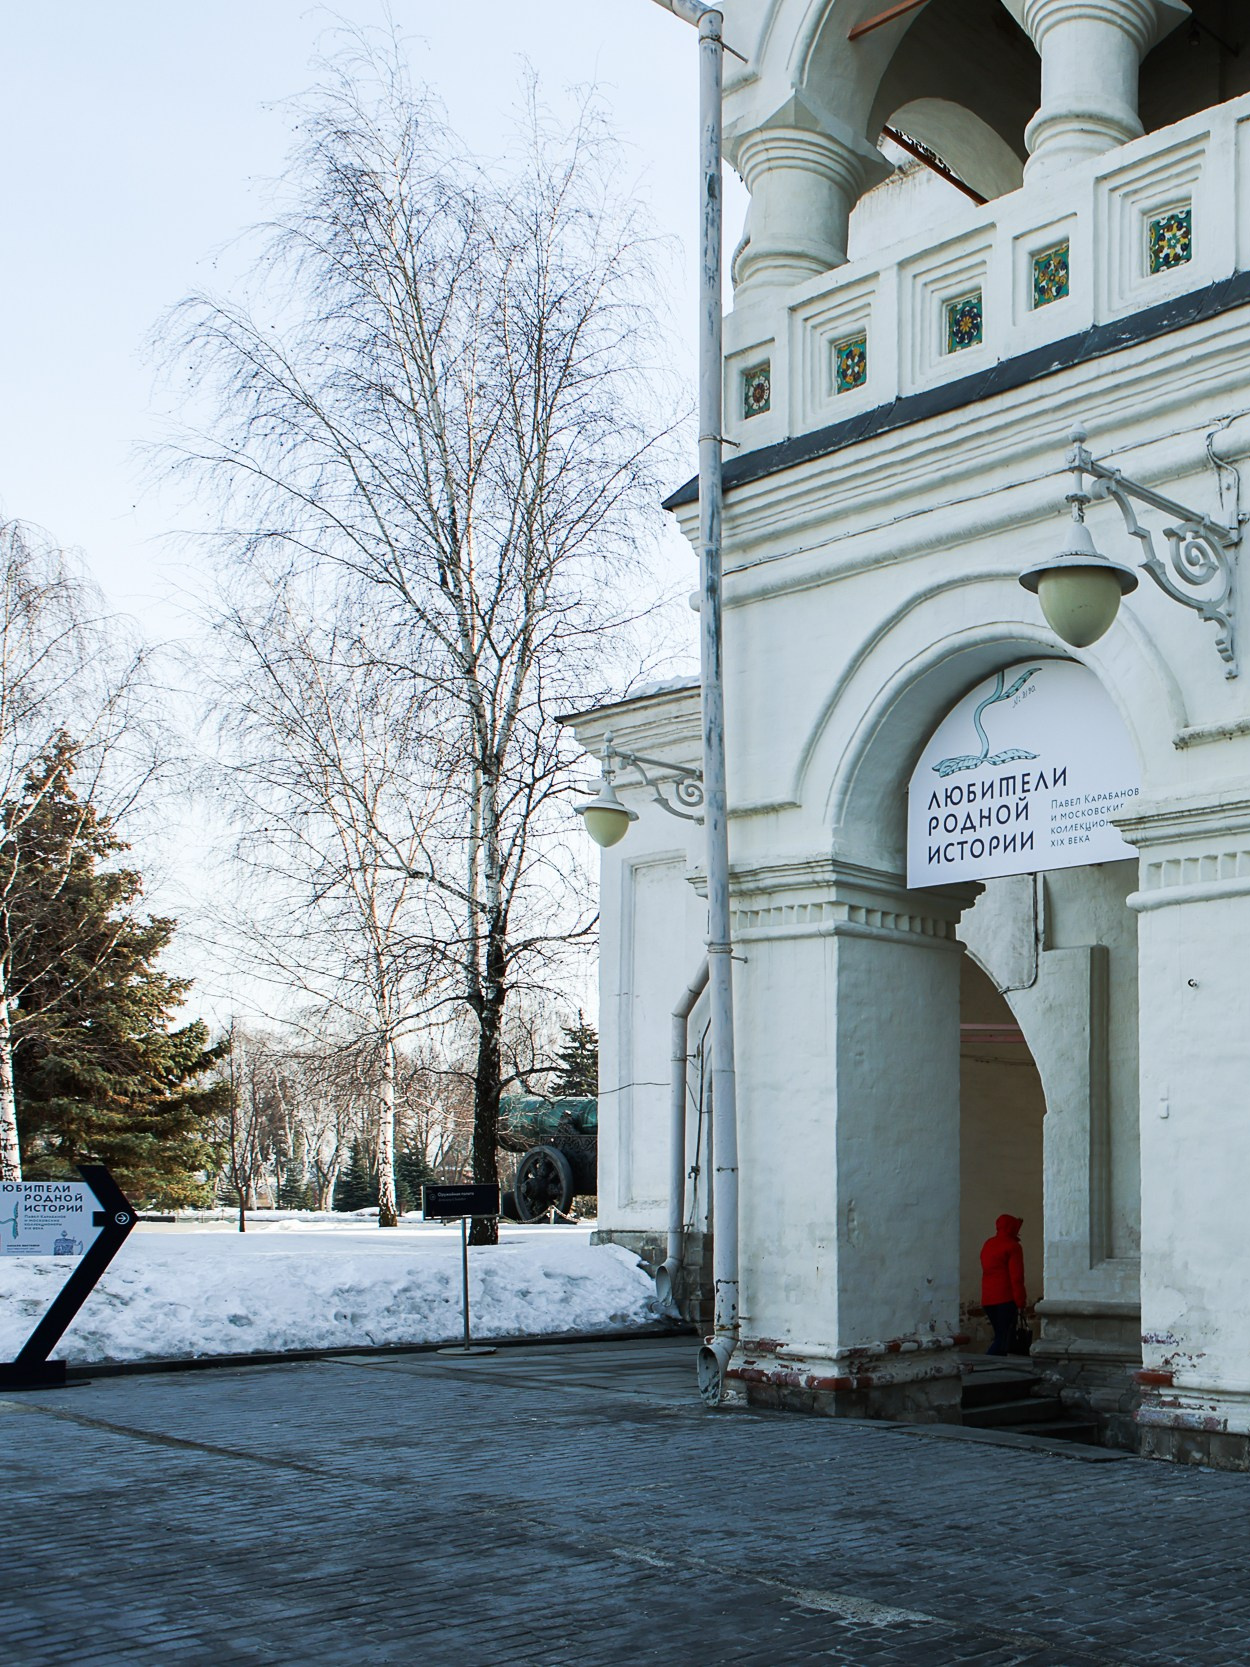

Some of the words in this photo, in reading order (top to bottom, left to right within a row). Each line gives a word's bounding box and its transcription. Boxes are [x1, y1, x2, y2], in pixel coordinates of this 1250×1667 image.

[927, 766, 1067, 811] ЛЮБИТЕЛИ
[927, 796, 1029, 837] РОДНОЙ
[927, 831, 1034, 865] ИСТОРИИ
[0, 1184, 71, 1193] ЮБИТЕЛИ
[24, 1192, 83, 1203] РОДНОЙ
[24, 1204, 83, 1213] ИСТОРИИ
